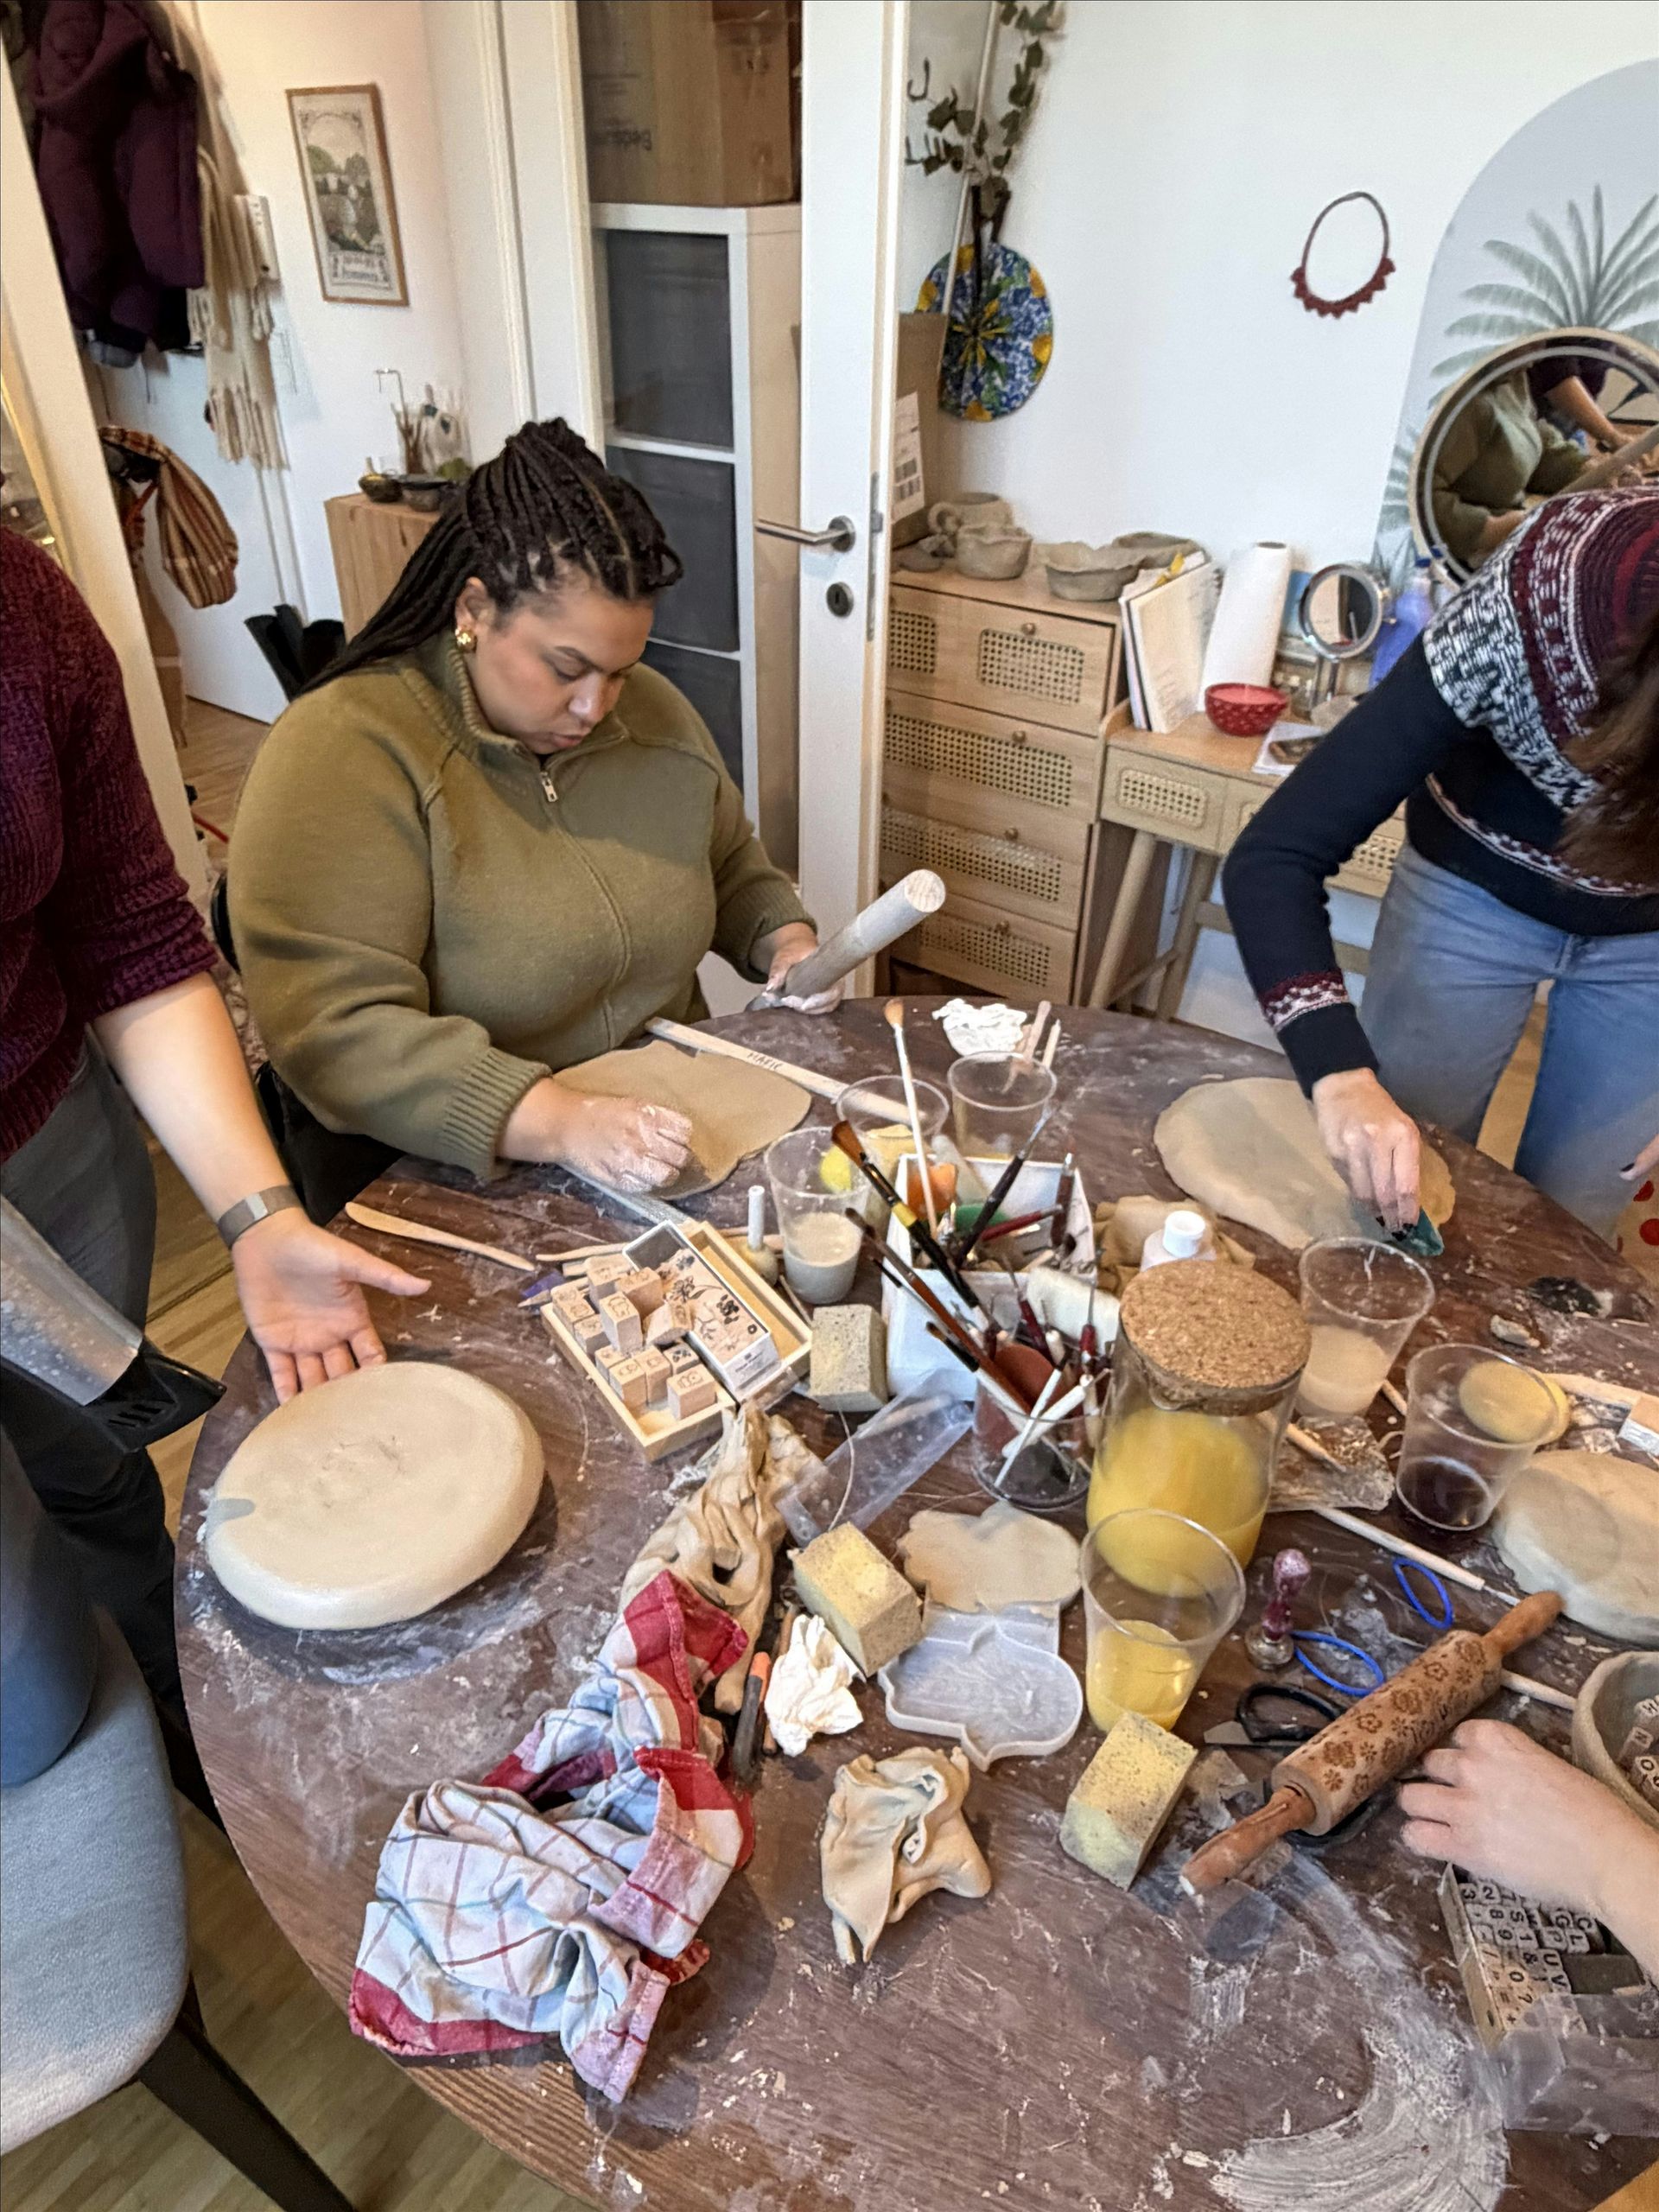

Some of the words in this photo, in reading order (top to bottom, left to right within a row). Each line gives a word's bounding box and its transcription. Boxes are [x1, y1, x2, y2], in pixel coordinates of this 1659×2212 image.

[1461, 1888, 1477, 1900] 3
[1482, 1885, 1496, 1901] 2
[1577, 1916, 1592, 1931] C
[1569, 1935, 1584, 1946] L
[1542, 1953, 1560, 1967] U
[1551, 1974, 1568, 1987] V
